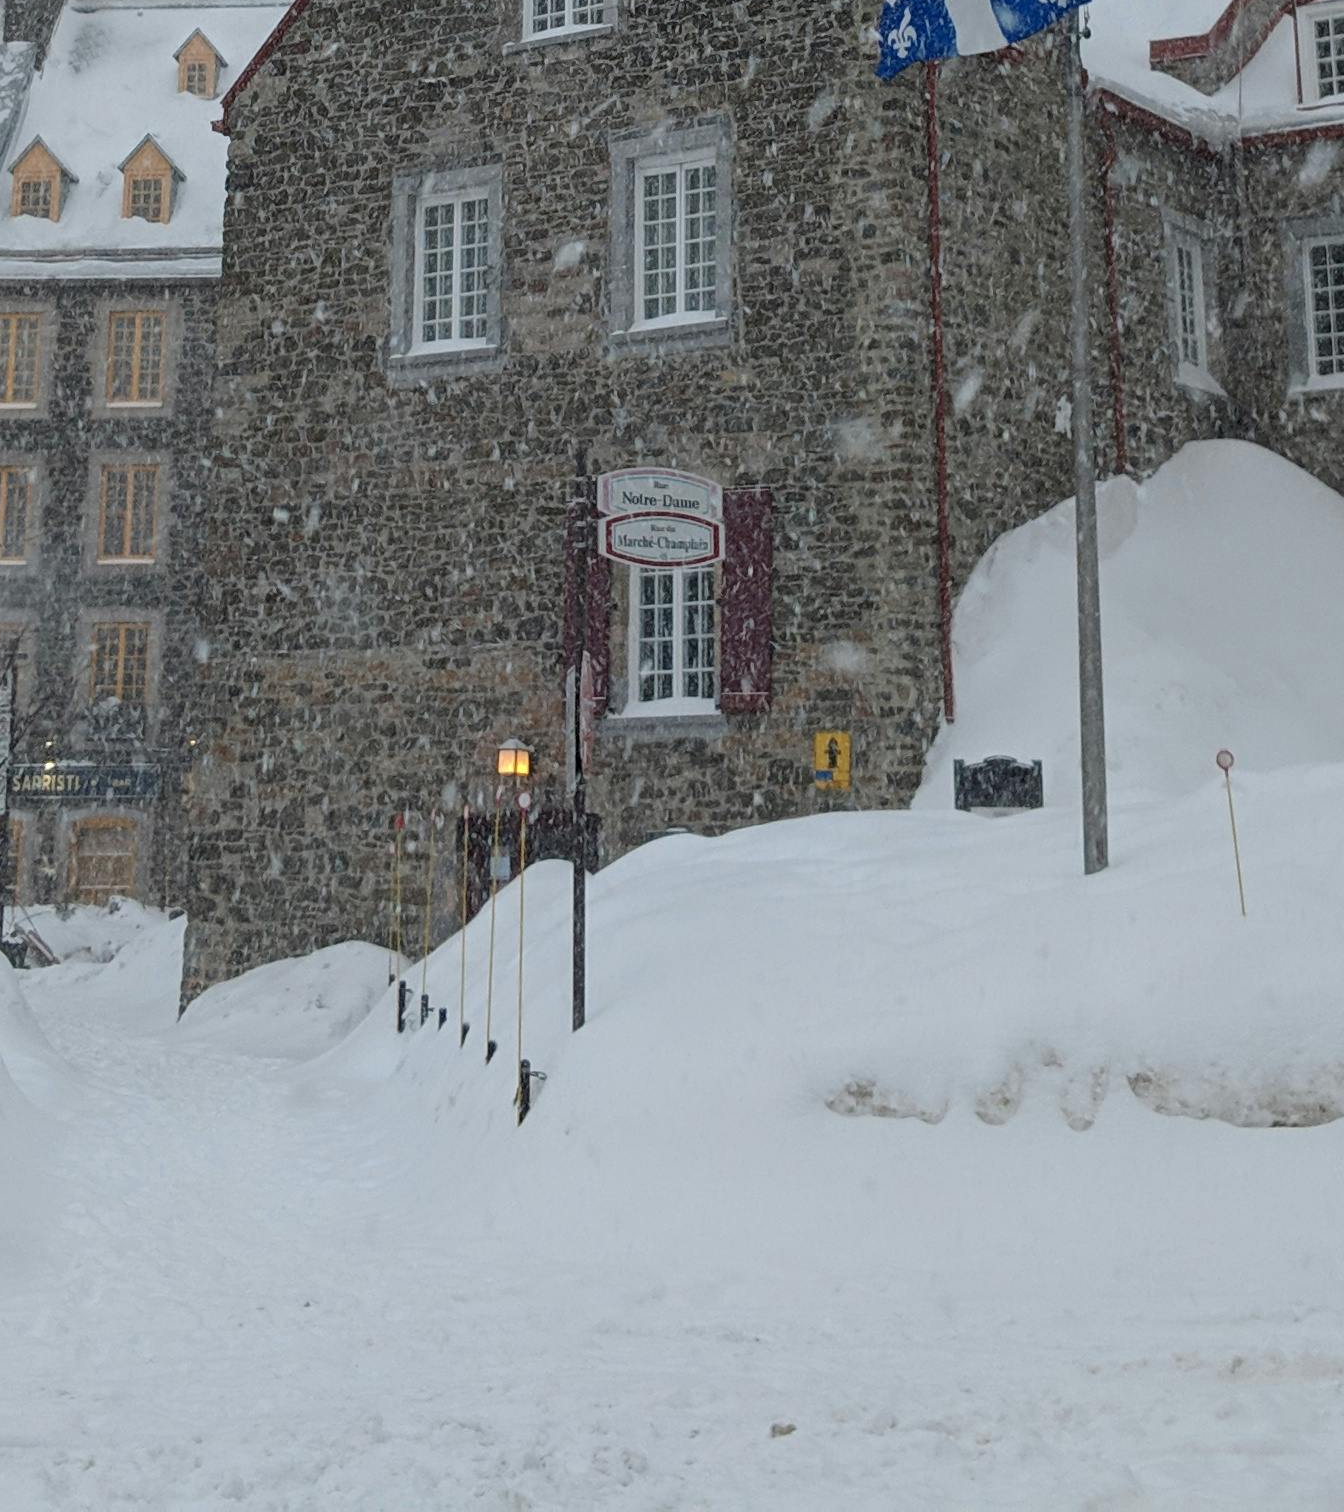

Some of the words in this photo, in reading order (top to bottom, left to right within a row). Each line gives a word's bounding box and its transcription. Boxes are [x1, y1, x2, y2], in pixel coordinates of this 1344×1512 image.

[654, 481, 669, 489] Rue
[622, 491, 700, 509] Notre-Dame
[618, 535, 708, 553] Marché-Champlain
